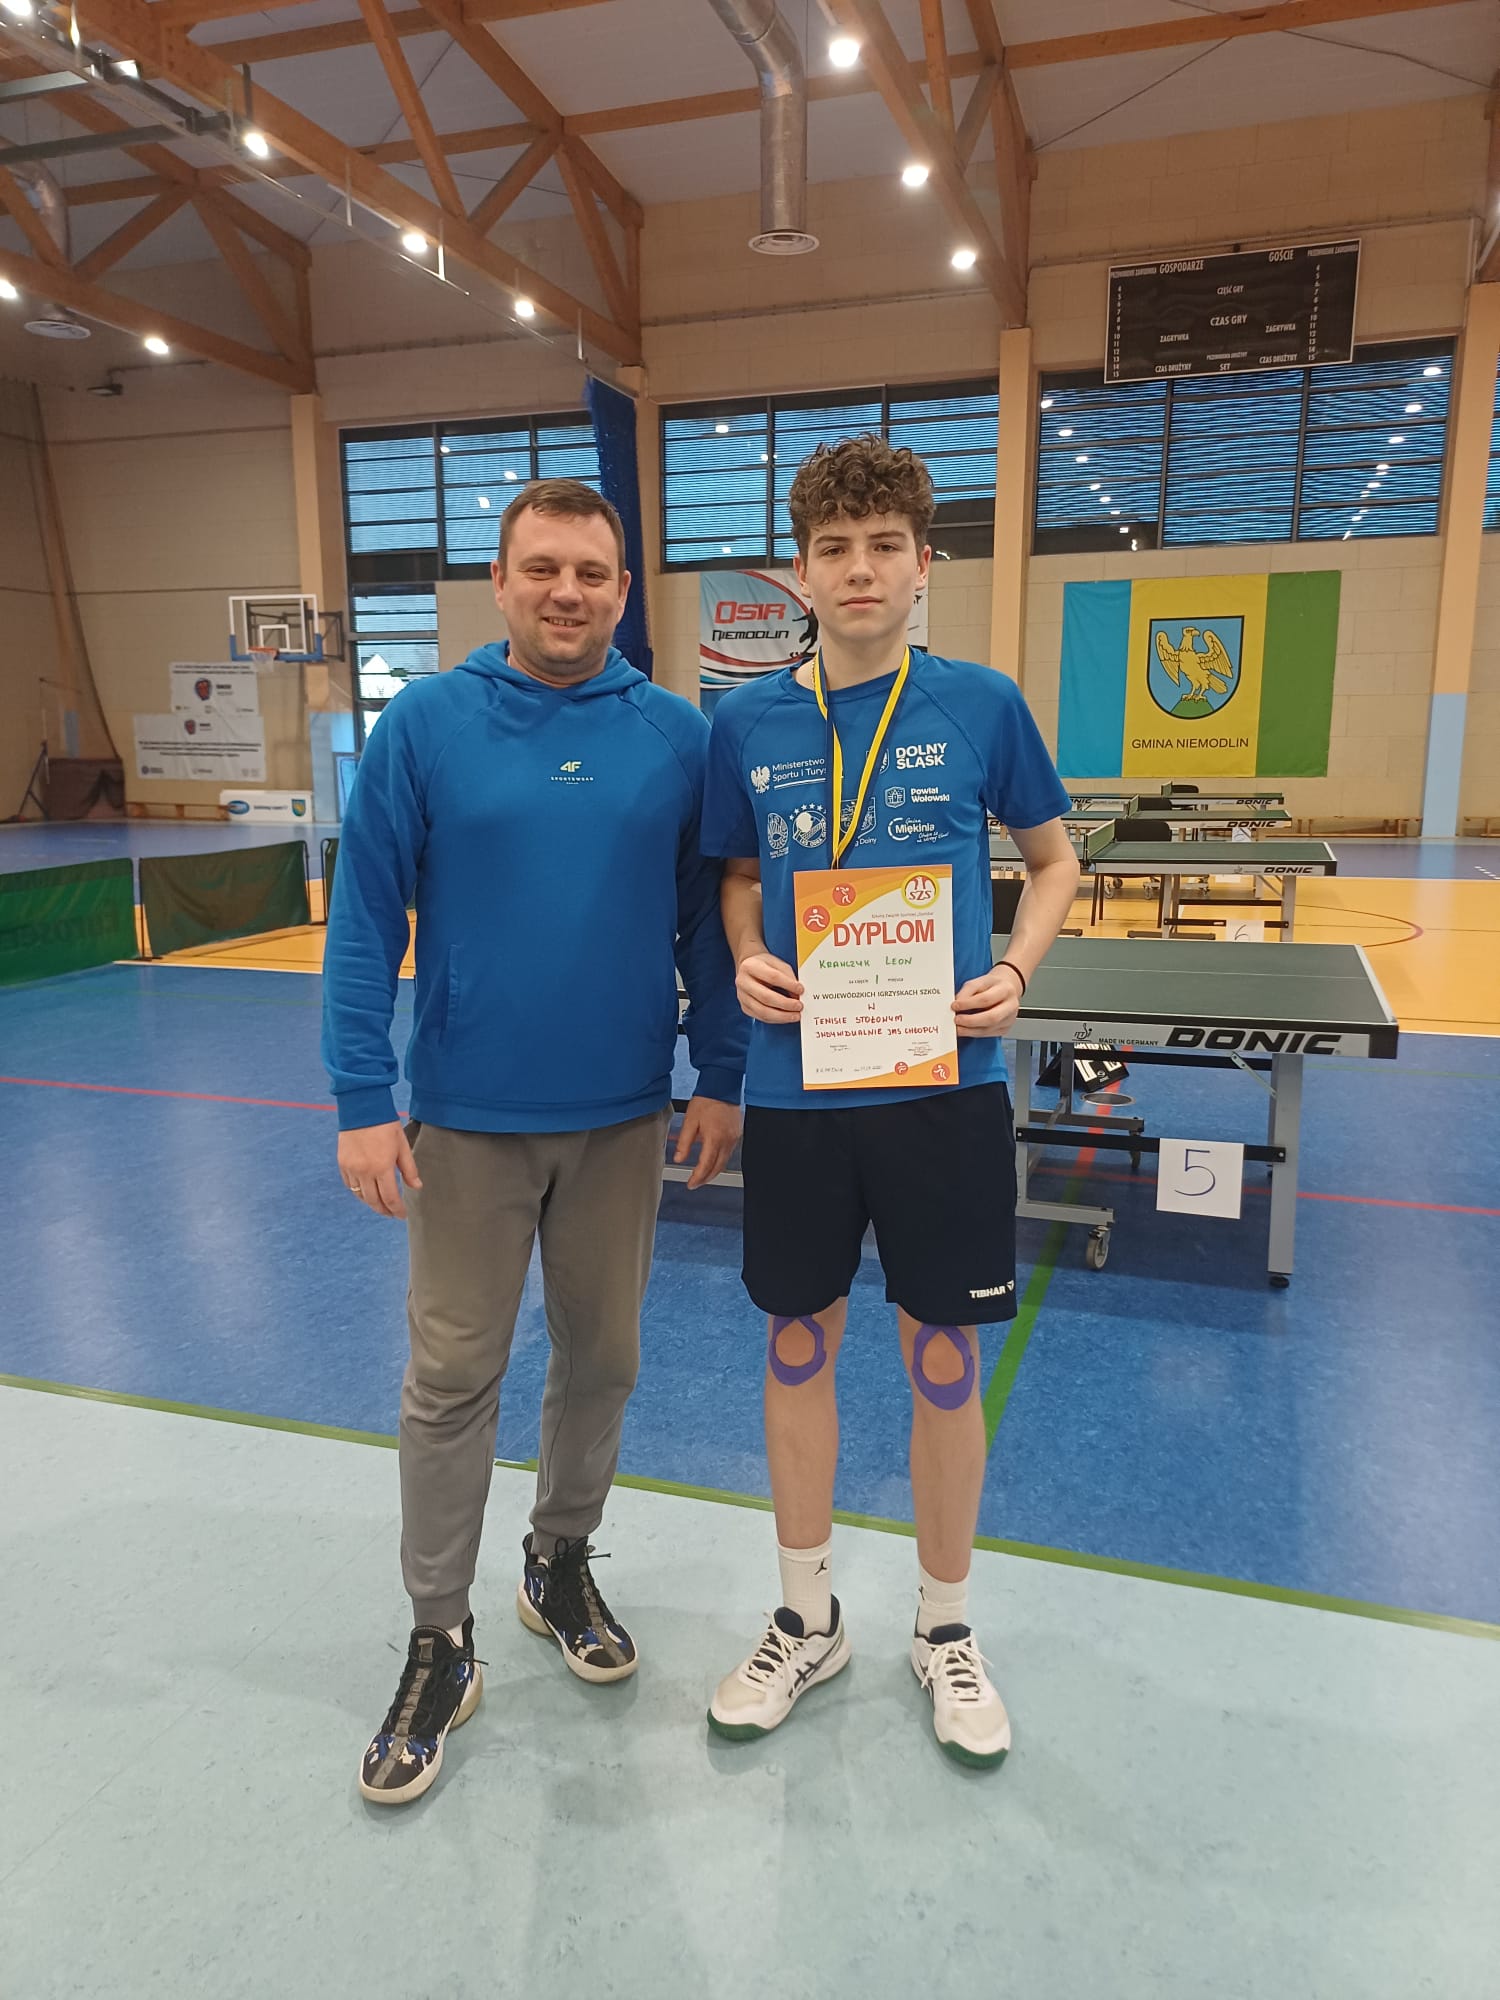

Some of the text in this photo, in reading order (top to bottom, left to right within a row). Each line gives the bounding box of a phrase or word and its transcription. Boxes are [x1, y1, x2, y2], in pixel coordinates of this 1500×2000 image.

[1268, 248, 1294, 262] GOŚCIE
[1159, 260, 1205, 274] GOSPODARZE
[1209, 314, 1248, 327] CZAS GRY
[1265, 323, 1296, 334] ZAGRYWKA
[1160, 333, 1190, 343] ZAGRYWKA
[1219, 363, 1231, 371] SET
[712, 629, 790, 642] NIEMODLIN
[1131, 737, 1249, 749] GMINA NIEMODLIN
[895, 742, 948, 759] DOLNY
[560, 760, 582, 773] 4F
[772, 758, 825, 772] Ministerstwo
[772, 770, 799, 783] Sportu
[1263, 866, 1313, 874] DONIC
[908, 890, 932, 901] SZS
[833, 918, 935, 948] DYPLOM
[885, 955, 913, 966] LEON
[821, 990, 876, 1001] WOJEWÓDZKICH
[877, 988, 918, 998] IGRZYSKACH
[919, 986, 942, 996] SZKÓŁ
[813, 1016, 847, 1026] TENISIE
[1098, 1037, 1116, 1045] MADE
[1165, 1026, 1343, 1055] DONIC
[1173, 1148, 1216, 1197] 5
[969, 1285, 1006, 1299] TIBHAR
